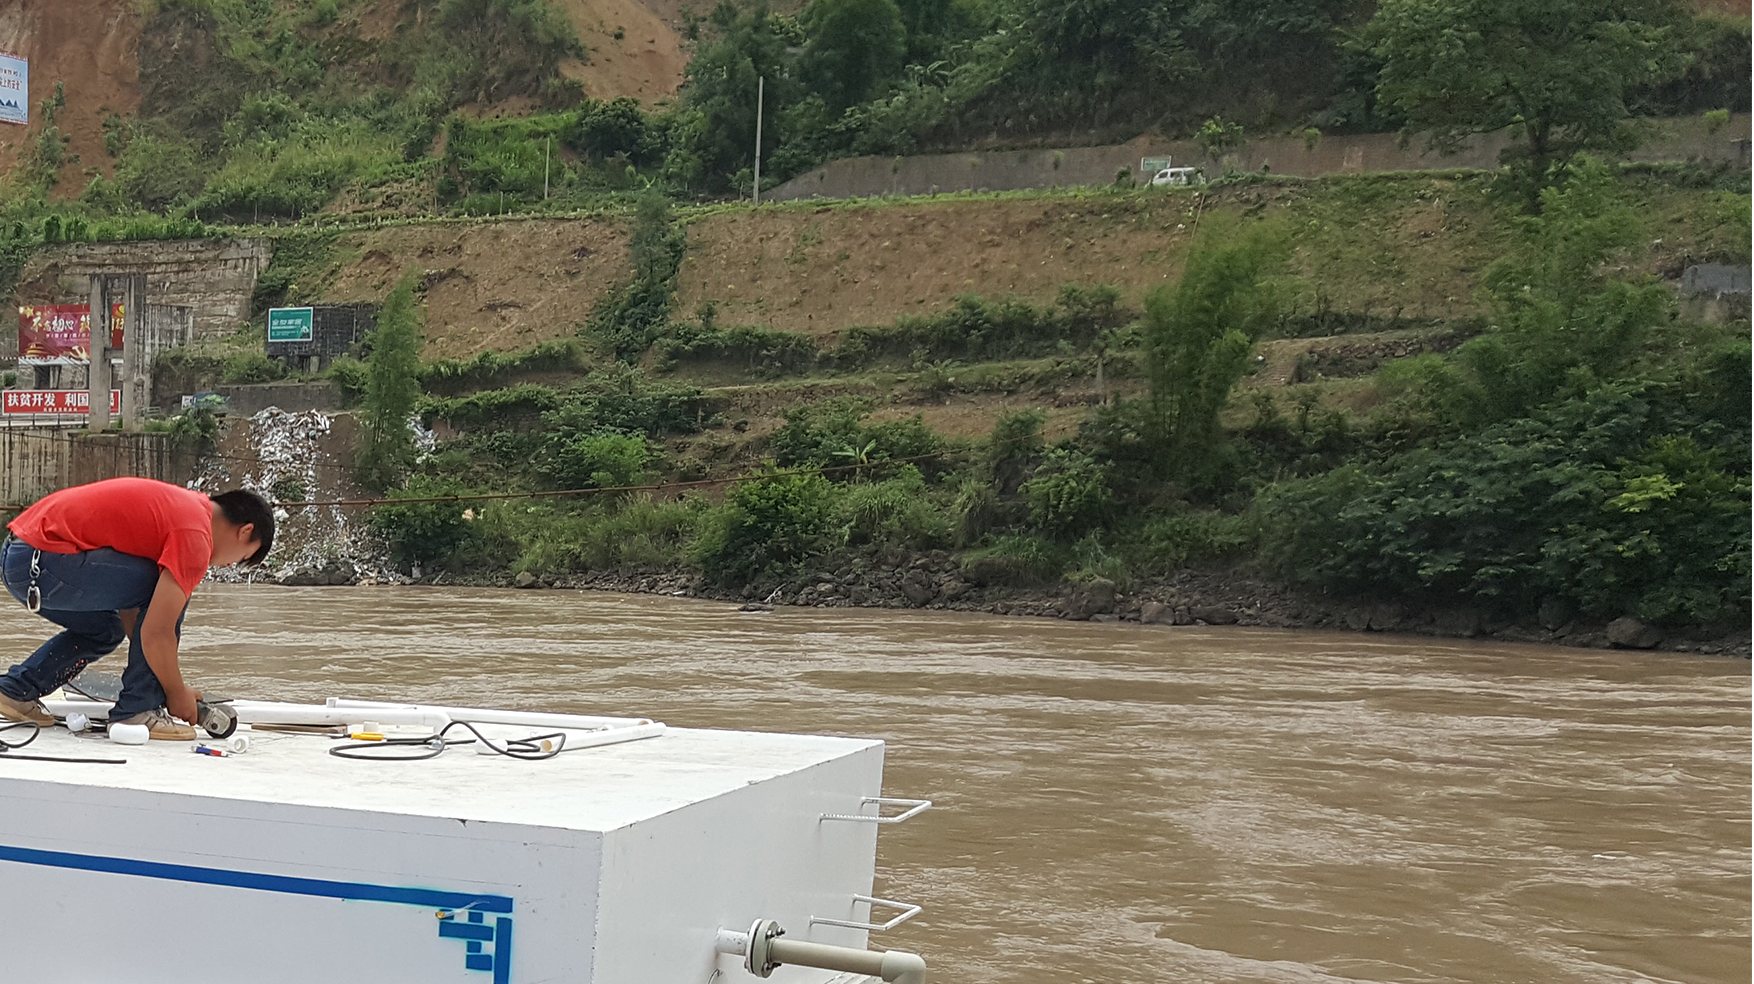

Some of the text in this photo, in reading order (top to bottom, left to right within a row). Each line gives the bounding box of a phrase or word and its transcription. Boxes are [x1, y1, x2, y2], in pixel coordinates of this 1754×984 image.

[32, 315, 75, 333] 不忘初心
[8, 392, 56, 407] 扶贫开发
